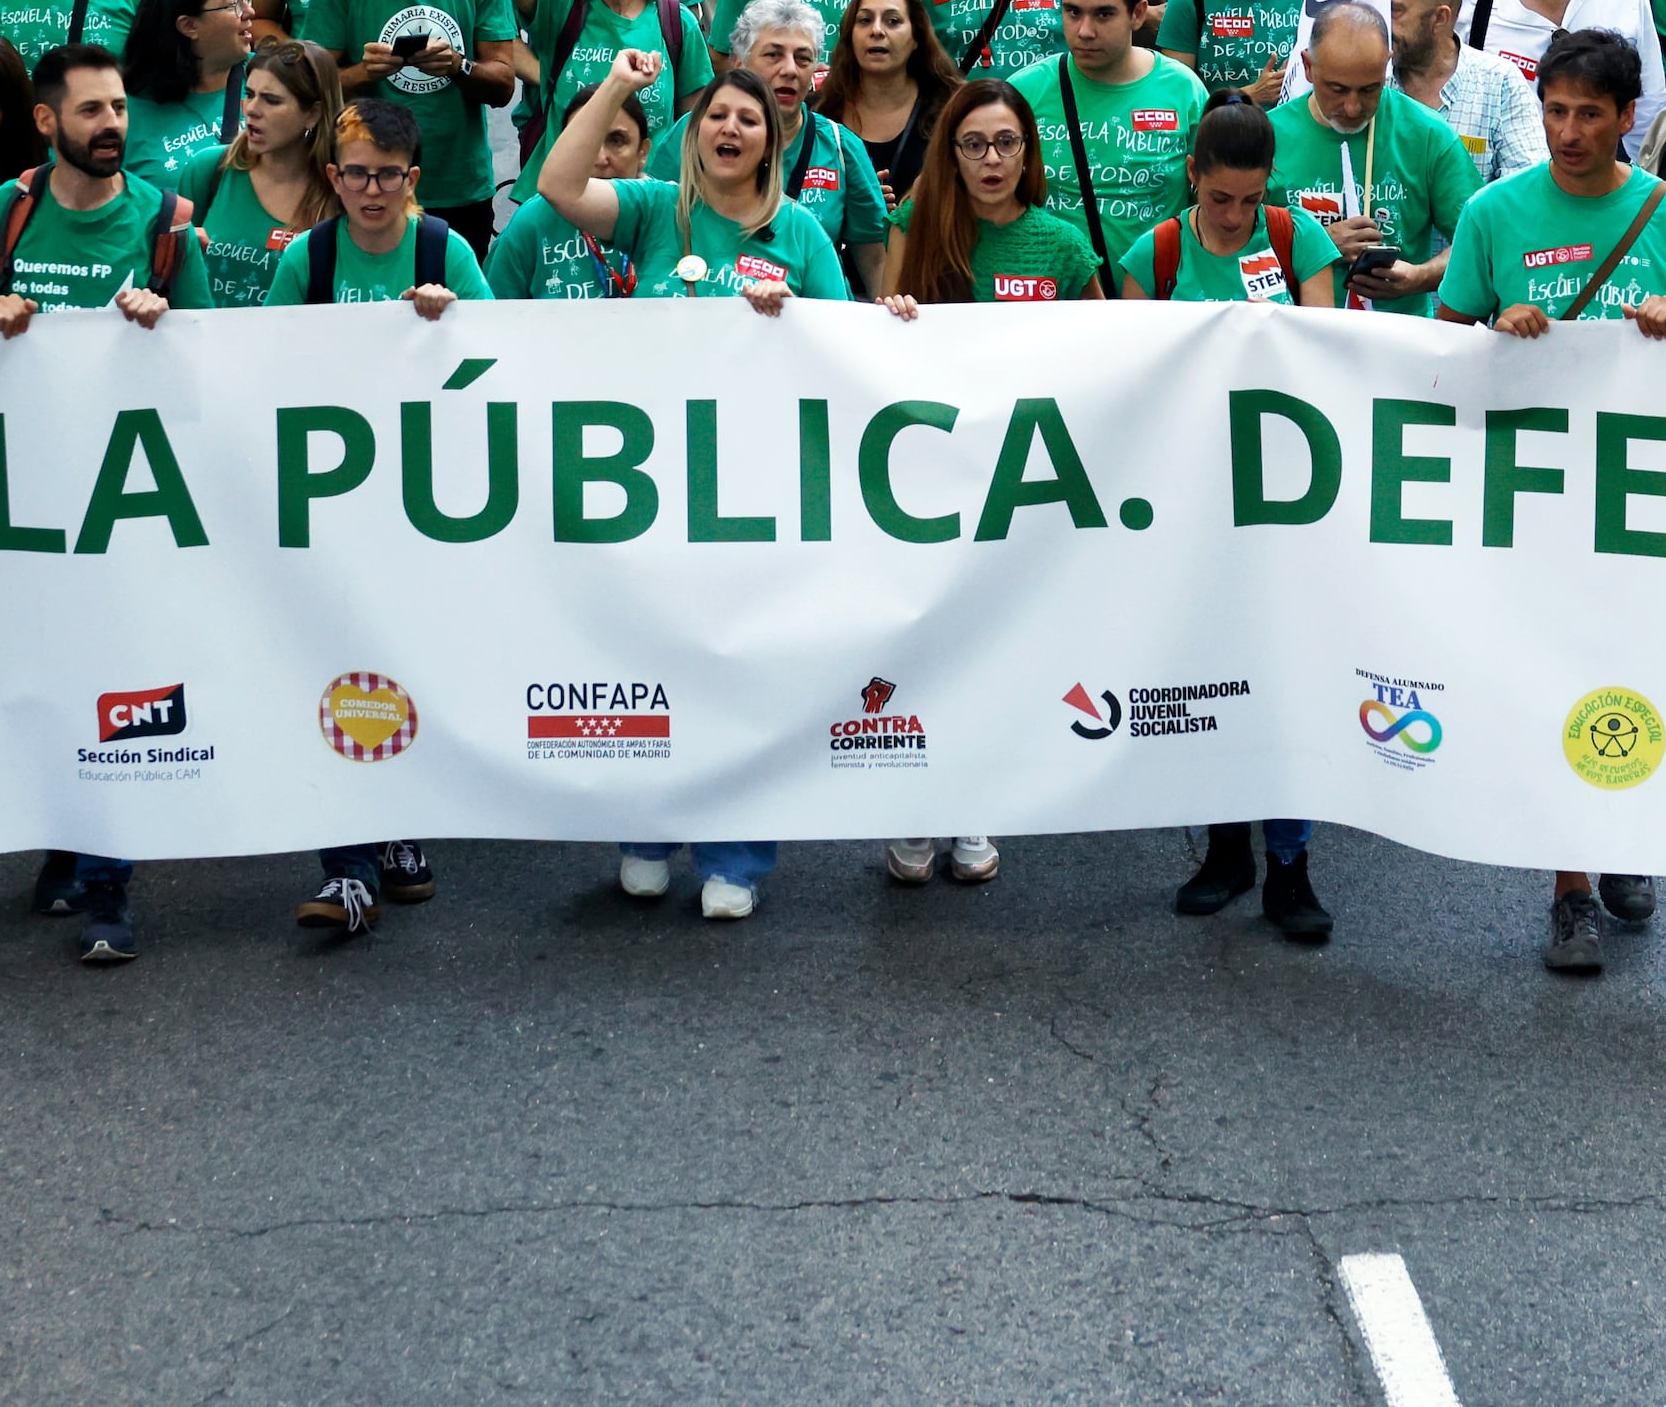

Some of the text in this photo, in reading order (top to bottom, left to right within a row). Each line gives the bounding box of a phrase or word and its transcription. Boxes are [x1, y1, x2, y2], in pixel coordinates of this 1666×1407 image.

[0, 6, 53, 28] ESCUELA
[1213, 17, 1252, 30] CCOO
[1134, 111, 1175, 123] CCOO
[1525, 251, 1554, 266] UGT
[13, 258, 112, 280] Queremos FP
[12, 280, 69, 296] de todas
[994, 275, 1037, 299] UGT
[1246, 270, 1287, 298] STEM
[277, 359, 1153, 548] PÚBLICA.
[1356, 668, 1445, 691] DEFENSA ALUMNADO
[527, 683, 669, 710] CONFAPA
[1129, 680, 1250, 704] COORDINADORA
[1373, 683, 1422, 710] TEA
[108, 699, 174, 727] CNT
[334, 708, 403, 722] UNIVERSAL
[339, 699, 397, 713] COMEDOR
[1129, 702, 1191, 720] JUVENIL
[830, 715, 924, 737] CONTRA
[1130, 717, 1217, 737] SOCIALISTA
[1568, 692, 1661, 744] EDUCACIÓN ESPECIAL
[527, 739, 576, 749] CONFEDERACIÓN
[577, 739, 615, 748] AUTONÓMICA
[653, 740, 671, 748] FAPAS
[830, 735, 926, 750] CORRIENTE
[77, 746, 215, 765] Sección Sindical
[528, 749, 670, 759] DE LA COMUNIDAD DE MADRID
[78, 768, 201, 783] Educación Pública CAM
